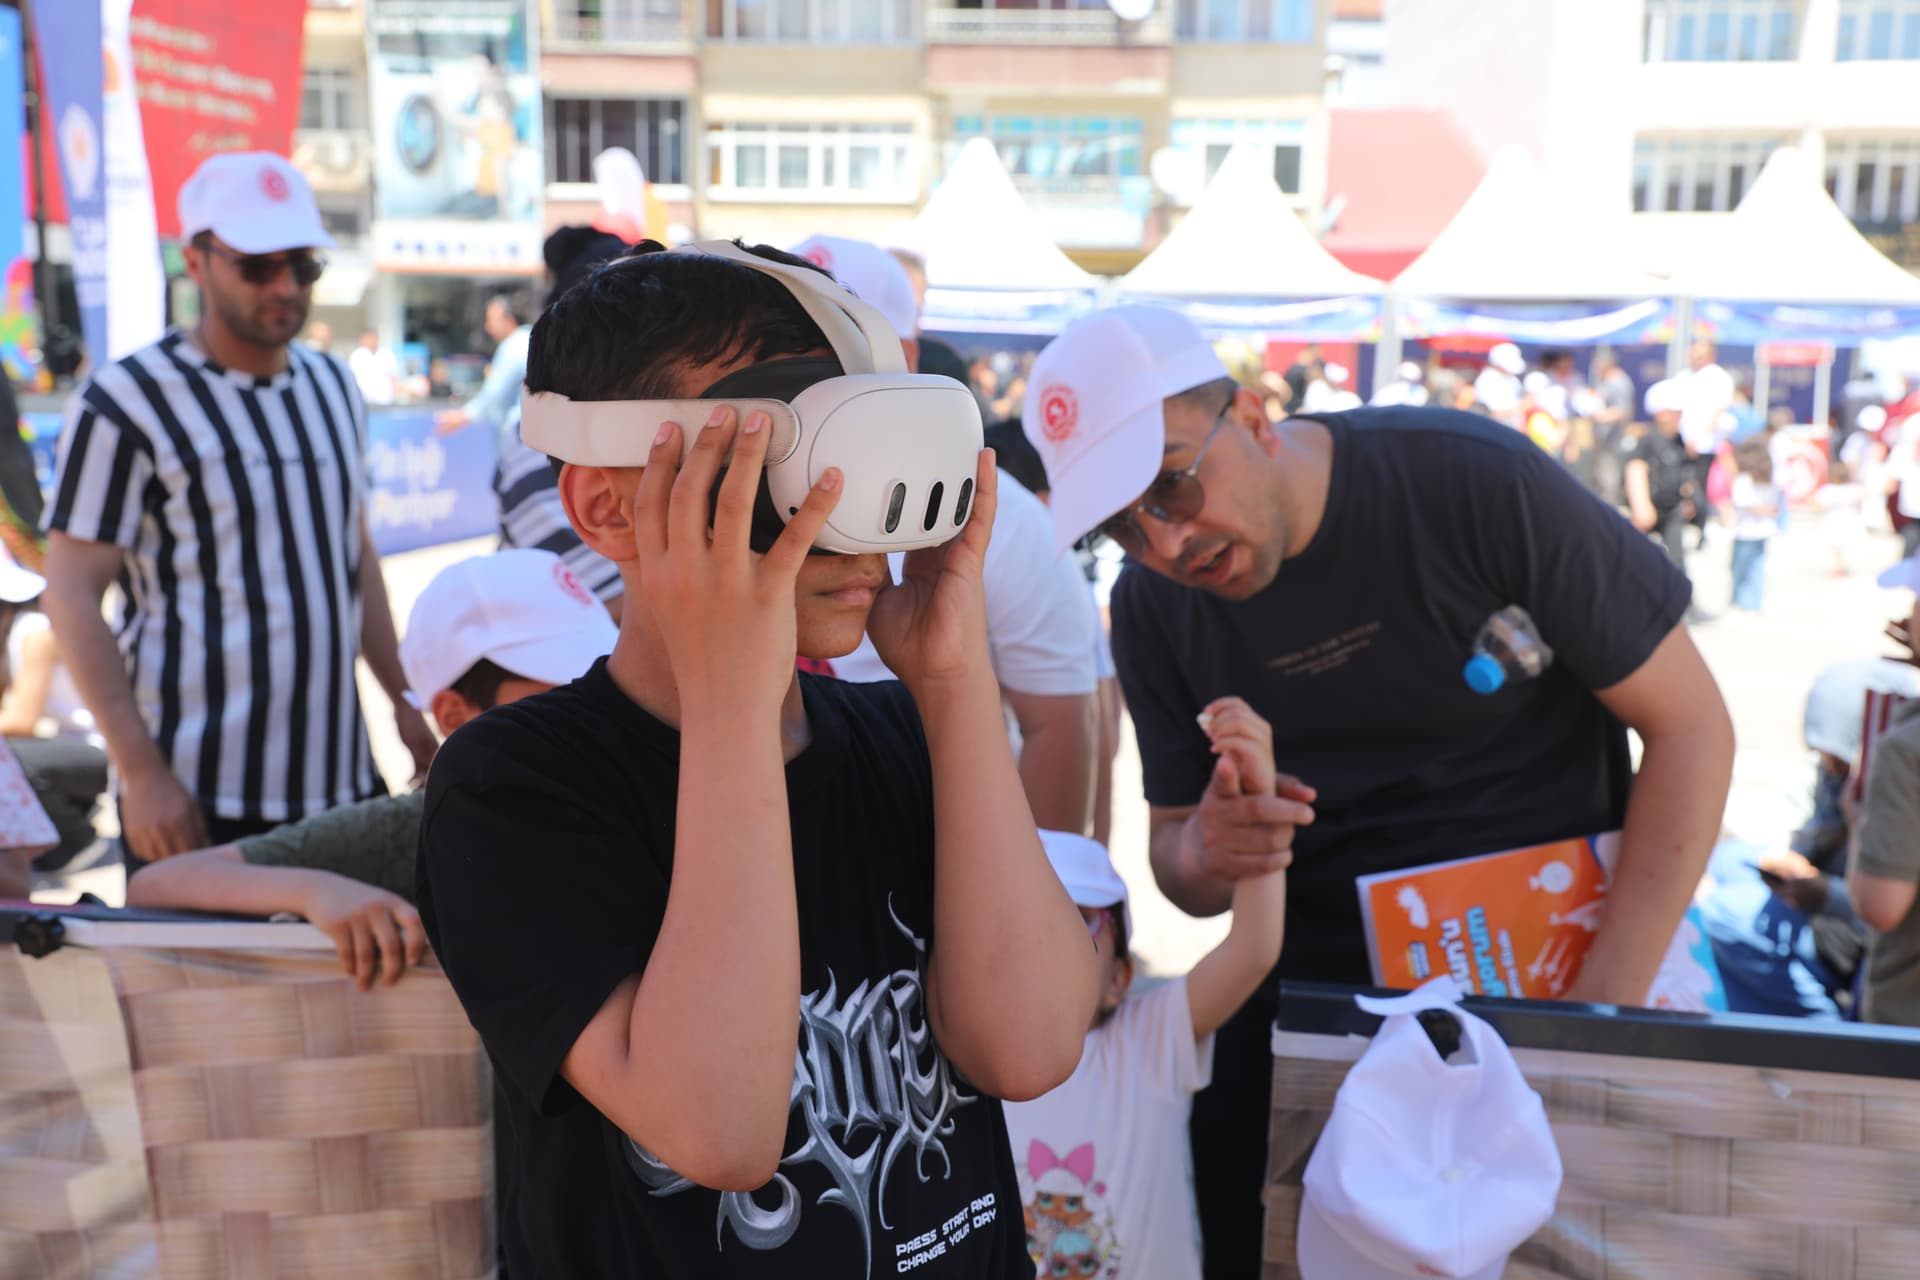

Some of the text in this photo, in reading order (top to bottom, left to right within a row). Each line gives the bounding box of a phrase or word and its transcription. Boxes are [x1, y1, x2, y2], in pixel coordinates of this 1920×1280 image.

[896, 1192, 995, 1257] PRESS START AND
[897, 1207, 997, 1273] CHANGE YOUR DAY
